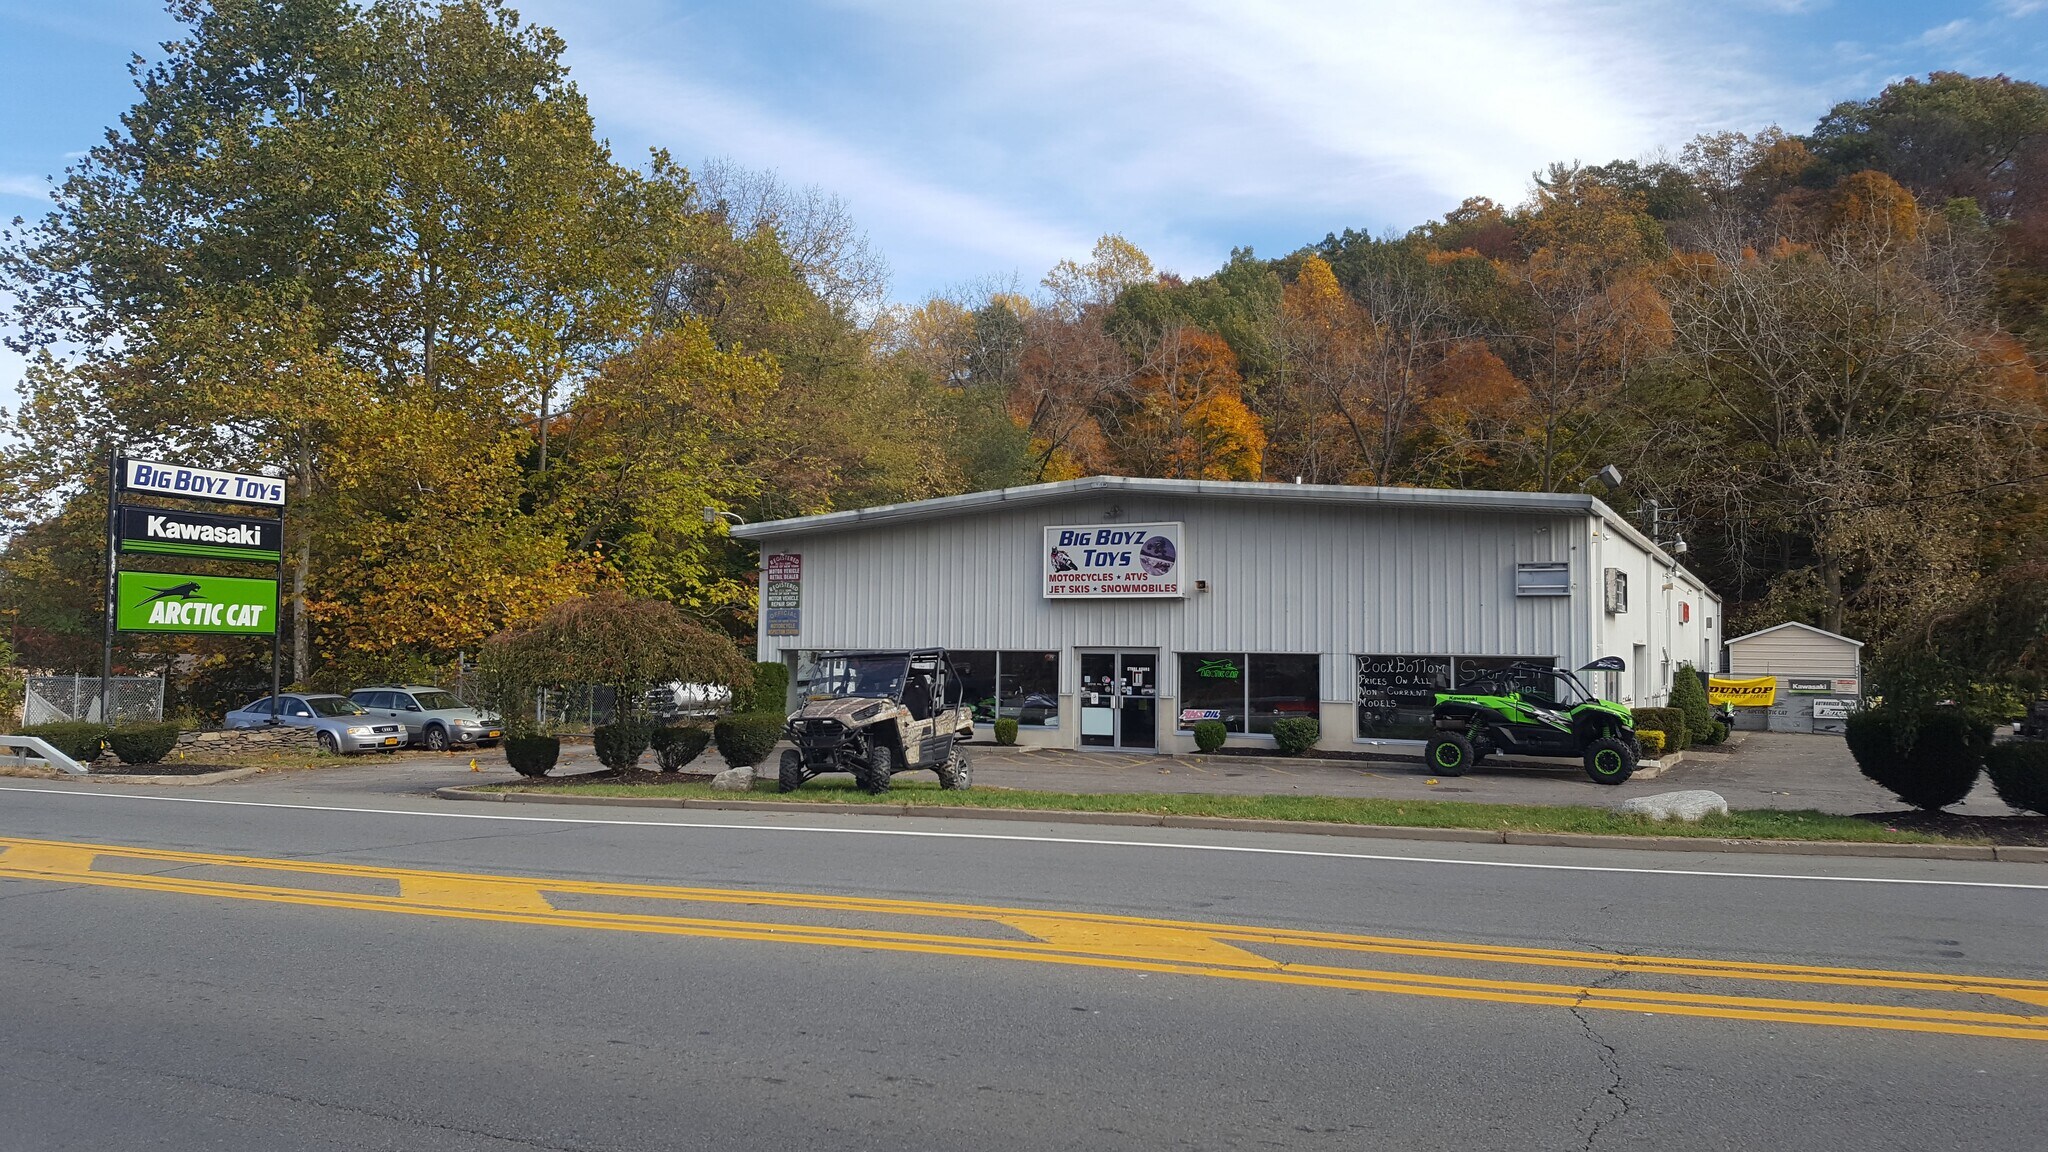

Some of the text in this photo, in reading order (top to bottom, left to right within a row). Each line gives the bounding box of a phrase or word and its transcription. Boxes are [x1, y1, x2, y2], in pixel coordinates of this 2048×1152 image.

[134, 464, 282, 501] BIG BOYZ TOYS
[147, 515, 261, 546] Kawasaki
[1059, 529, 1147, 547] BIG BOYZ
[1083, 549, 1132, 567] TOYS
[1049, 572, 1148, 582] MOTORCYCLES ATVS
[1049, 583, 1177, 594] JET SKIS SNOWMOBILES
[148, 601, 264, 627] ARCTIC CAT
[1358, 698, 1397, 707] MODELS
